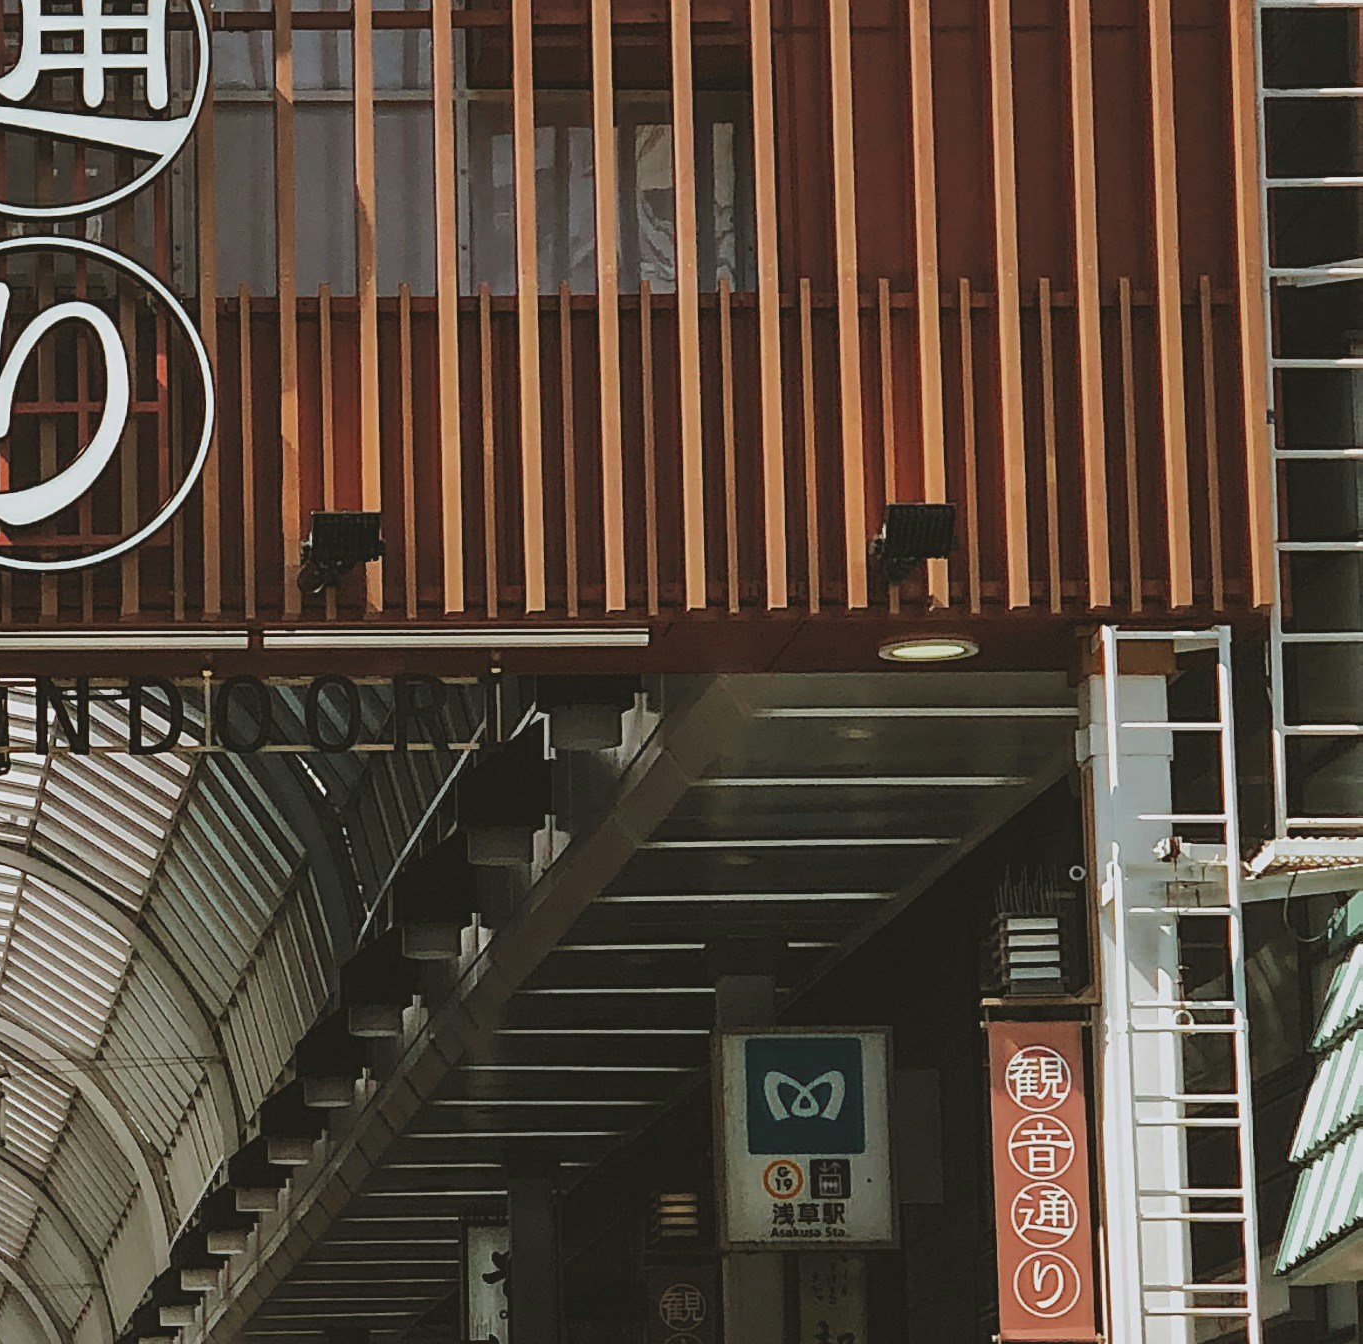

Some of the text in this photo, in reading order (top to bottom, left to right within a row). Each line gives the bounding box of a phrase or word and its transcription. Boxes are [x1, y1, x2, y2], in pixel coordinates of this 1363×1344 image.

[775, 1178, 793, 1192] 19
[1006, 1050, 1075, 1313] 観音通り
[772, 1203, 846, 1226] 浅草駅
[771, 1227, 822, 1238] Asakusa
